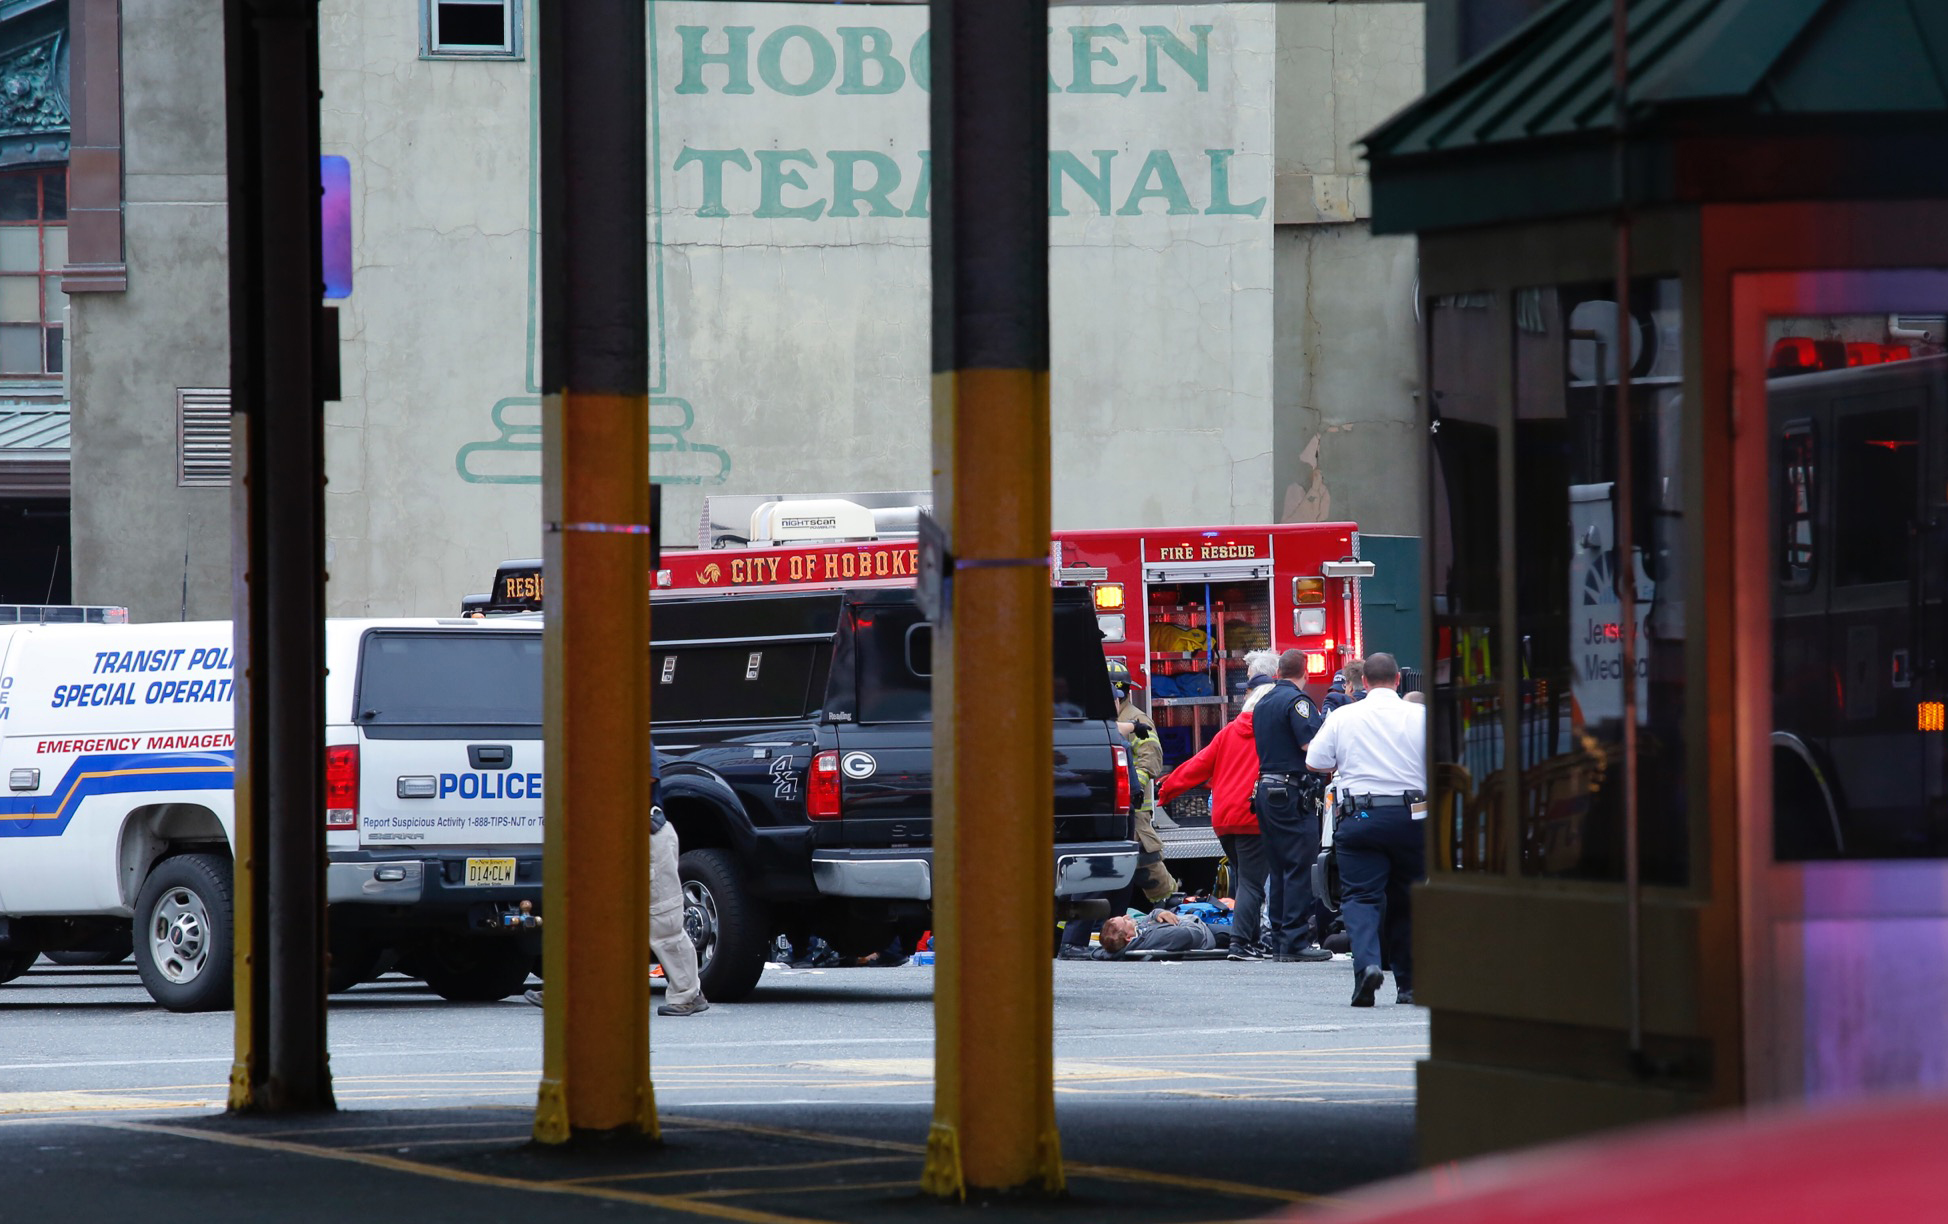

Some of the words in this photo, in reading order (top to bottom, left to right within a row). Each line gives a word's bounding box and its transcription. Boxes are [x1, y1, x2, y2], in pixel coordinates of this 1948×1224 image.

[674, 22, 1213, 97] HOBEN
[673, 147, 1268, 220] TERNAL
[1160, 546, 1194, 560] FIRE
[1201, 545, 1256, 559] RESCUE
[730, 556, 782, 584] CITY
[789, 554, 817, 581] OF
[92, 649, 186, 674] TRANSIT
[51, 682, 137, 708] SPECIAL
[36, 737, 142, 754] EMERGENCY
[843, 753, 875, 777] G
[439, 772, 542, 800] POLICE
[363, 816, 390, 828] Report
[392, 816, 435, 829] Suspicious
[437, 816, 466, 829] Activity
[528, 818, 537, 826] or
